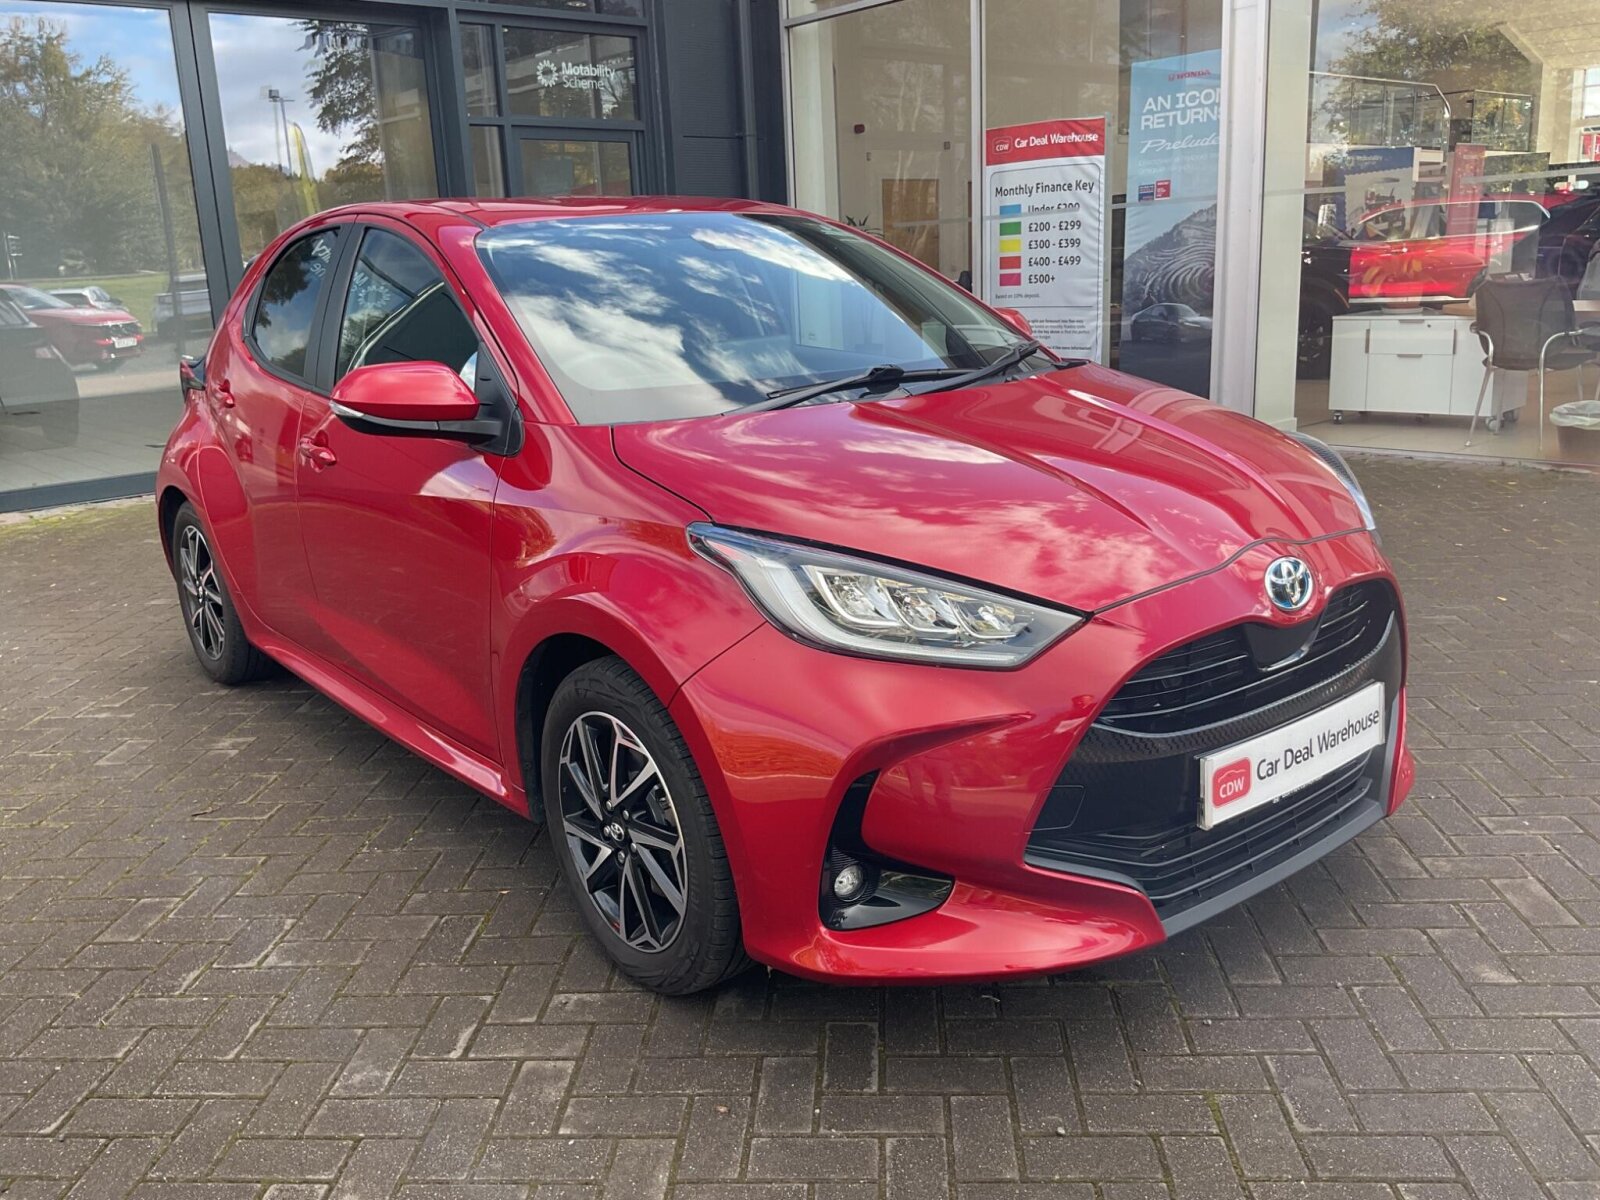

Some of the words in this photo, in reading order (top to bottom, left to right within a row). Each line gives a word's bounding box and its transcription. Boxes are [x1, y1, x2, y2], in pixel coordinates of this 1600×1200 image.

[561, 62, 615, 80] Motability
[562, 76, 604, 90] Scheme
[1143, 94, 1171, 113] AN
[1140, 105, 1221, 131] RETURN
[995, 143, 1009, 152] CDW
[1014, 138, 1028, 149] Car
[1029, 134, 1048, 147] Deal
[1050, 132, 1099, 145] Warehouse
[995, 184, 1034, 198] Monthly
[1035, 181, 1073, 194] Finance
[1075, 179, 1095, 194] Key
[1028, 221, 1051, 233] £200
[1058, 219, 1082, 231] £299
[1028, 239, 1051, 250] £300
[1058, 238, 1081, 249] £399
[1028, 257, 1051, 267] £400
[1058, 255, 1081, 266] £499
[1028, 274, 1055, 284] £500+
[1219, 776, 1245, 798] CDW
[1256, 757, 1280, 781] Car
[1284, 738, 1314, 770] Deal
[1317, 709, 1380, 754] Warehouse
